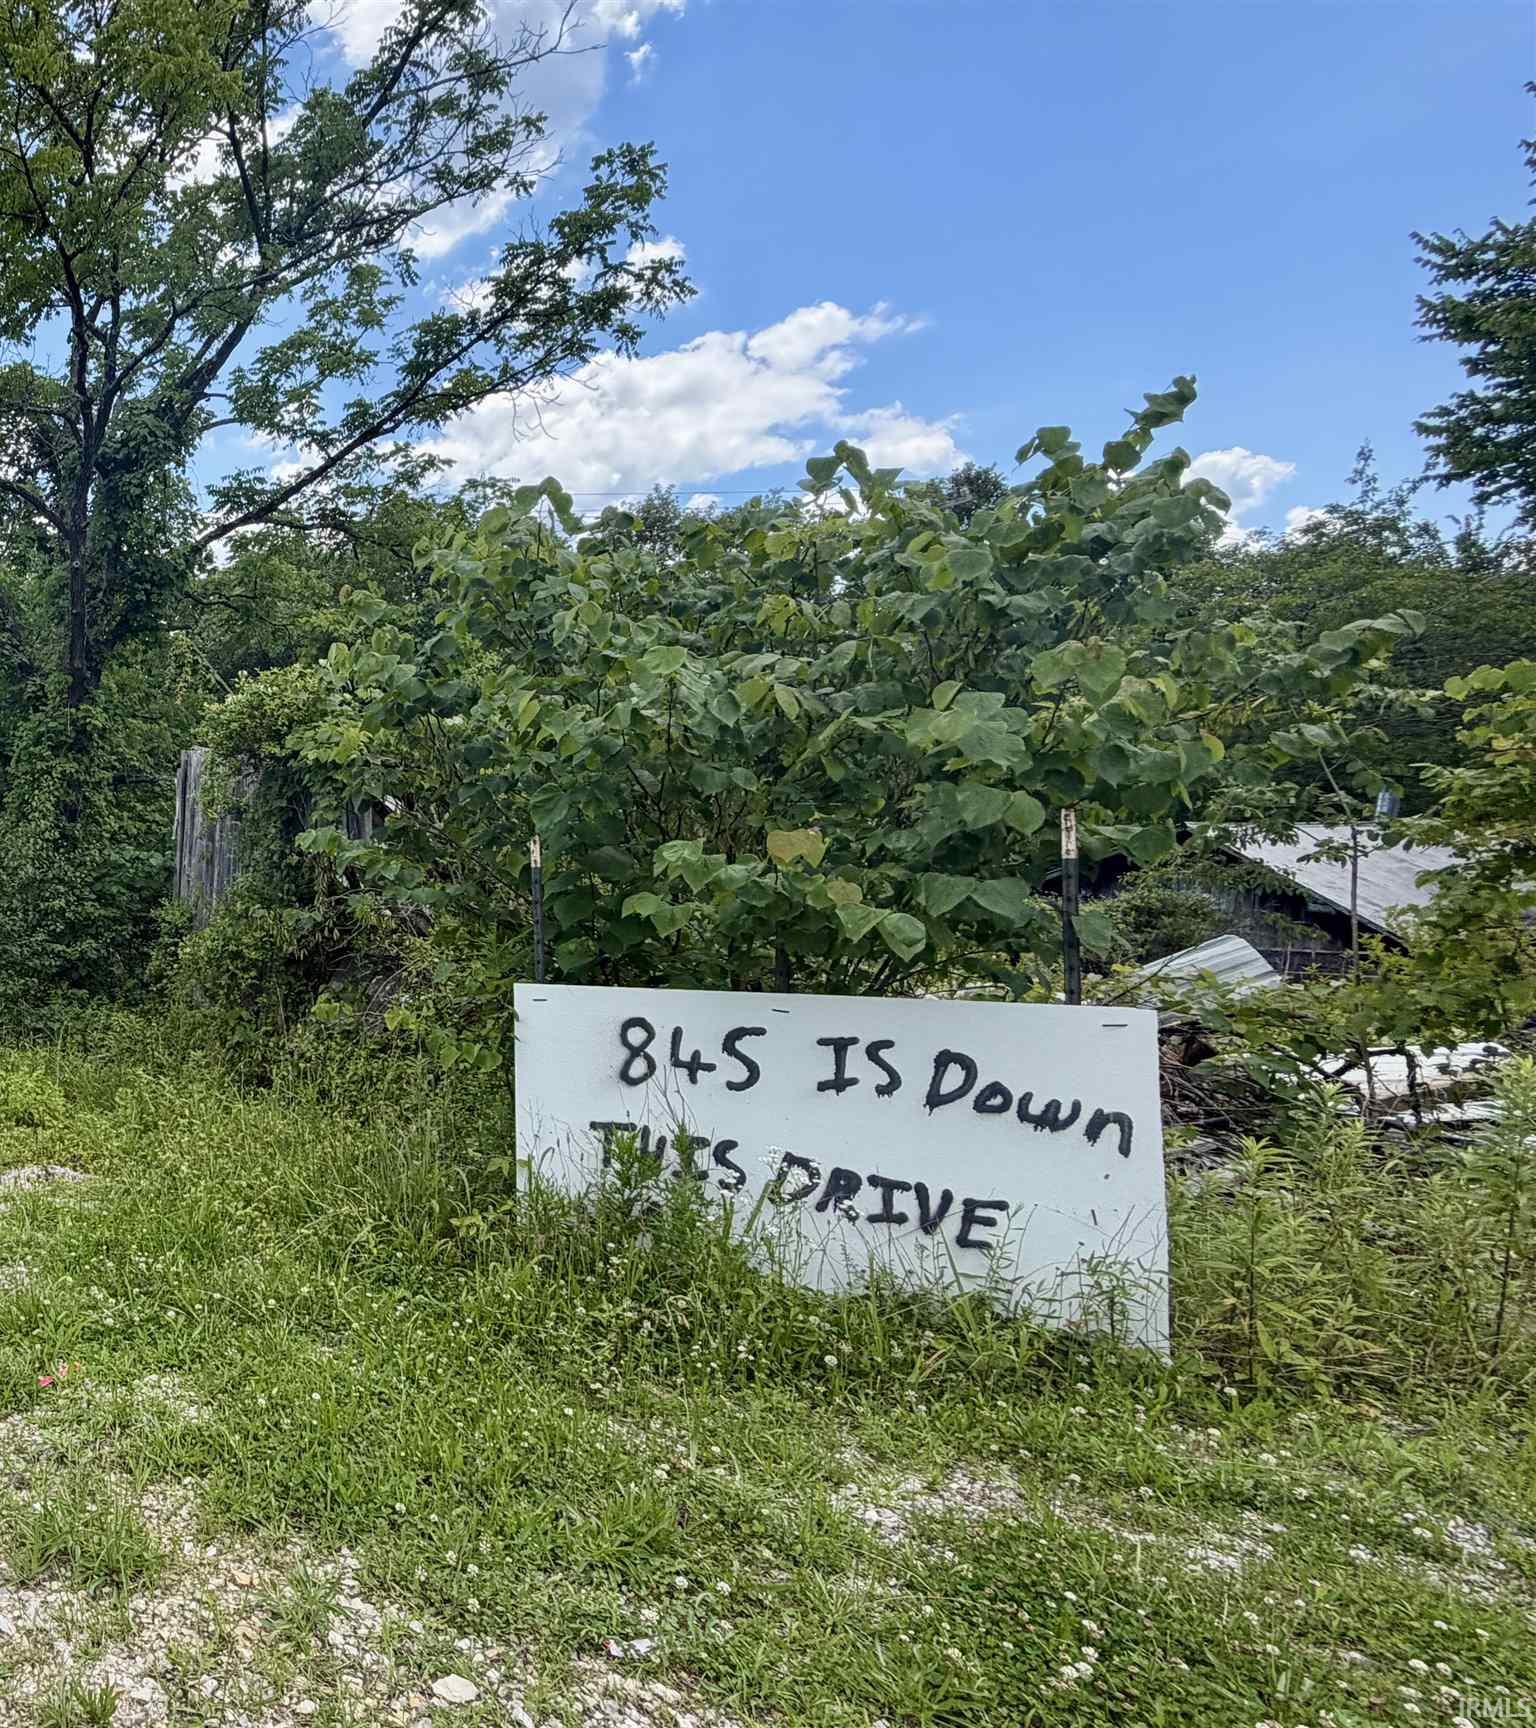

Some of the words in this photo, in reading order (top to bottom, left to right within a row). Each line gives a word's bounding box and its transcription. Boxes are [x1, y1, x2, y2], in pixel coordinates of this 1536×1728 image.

[619, 1016, 767, 1092] 845
[816, 1036, 902, 1098] IS
[767, 1151, 1009, 1249] DRIVE
